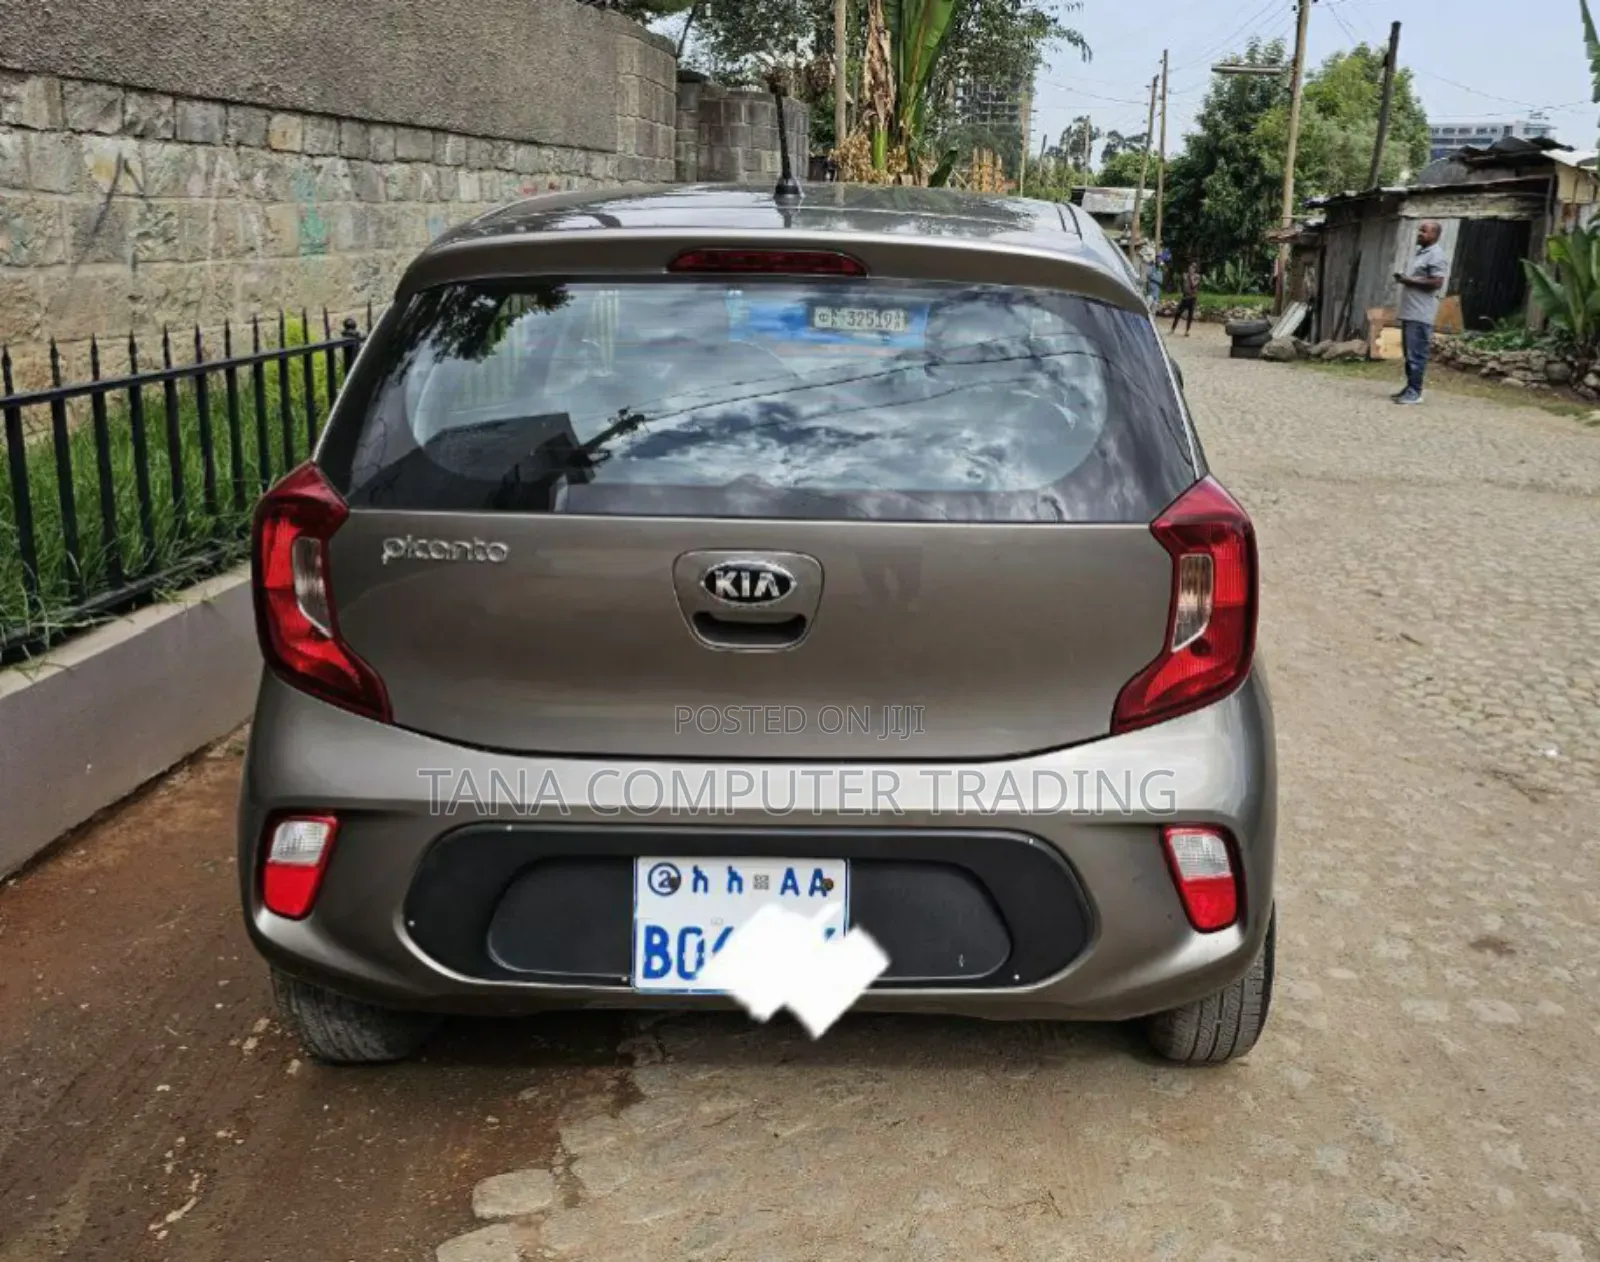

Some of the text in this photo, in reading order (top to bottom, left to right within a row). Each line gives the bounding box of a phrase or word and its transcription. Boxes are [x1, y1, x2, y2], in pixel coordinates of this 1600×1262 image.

[381, 534, 510, 565] picanto
[714, 570, 780, 598] KIA
[779, 867, 828, 897] AA
